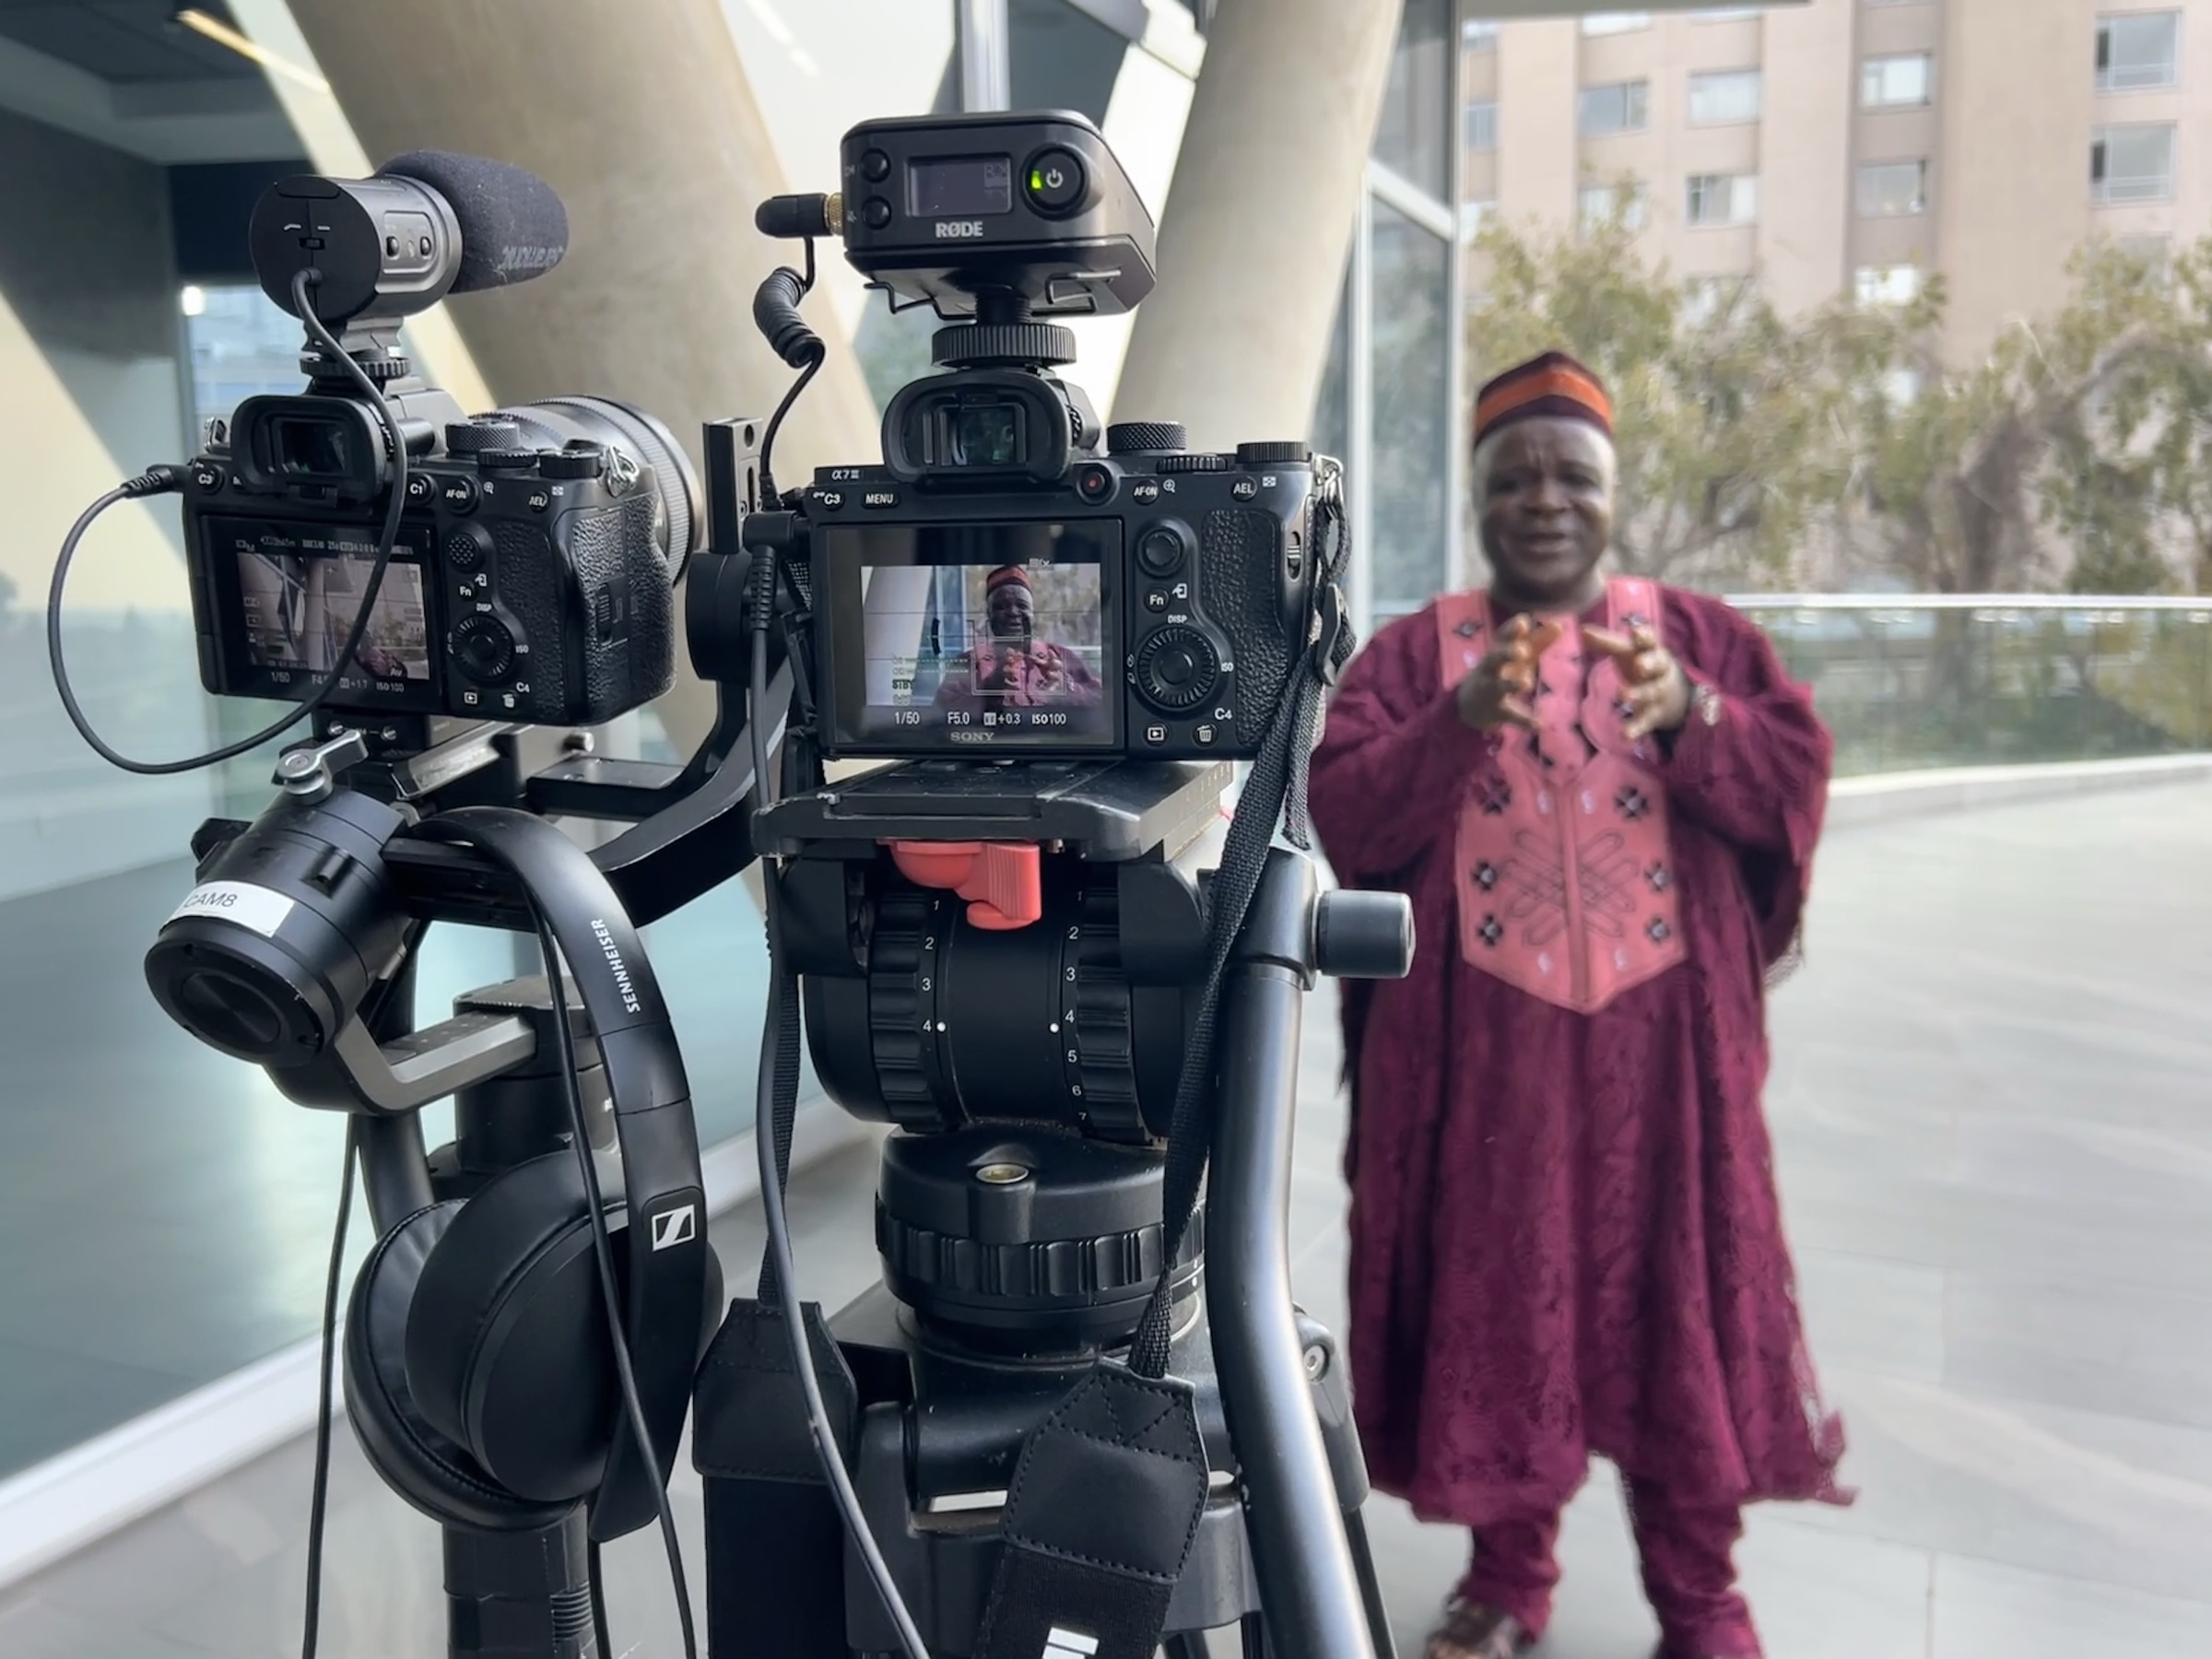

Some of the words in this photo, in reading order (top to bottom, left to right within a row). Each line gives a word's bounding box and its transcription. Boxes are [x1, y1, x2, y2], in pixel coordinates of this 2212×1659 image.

[935, 221, 983, 239] RØDE
[198, 474, 213, 485] C3
[410, 484, 423, 494] C1
[1134, 486, 1158, 497] AF-ON
[1233, 483, 1253, 495] AEL
[824, 493, 841, 505] C3
[865, 493, 894, 505] MENU
[459, 585, 472, 597] Fn
[1149, 594, 1164, 606] Fn
[1168, 615, 1187, 624] DISP
[515, 644, 529, 653] ISO
[1221, 663, 1234, 672] ISO
[516, 682, 530, 693] C4
[894, 712, 920, 725] 1/50
[947, 712, 970, 725] F5.0
[1215, 708, 1233, 720] C4
[950, 732, 994, 742] SONY
[1068, 926, 1078, 940] 2
[924, 936, 935, 950] 2
[591, 918, 641, 1013] SENNHEISER
[1066, 967, 1076, 982] 3
[922, 977, 932, 992] 3
[1065, 1009, 1075, 1023] 4
[923, 1020, 932, 1032] 4
[1067, 1050, 1077, 1063] 5
[1072, 1085, 1082, 1097] 6
